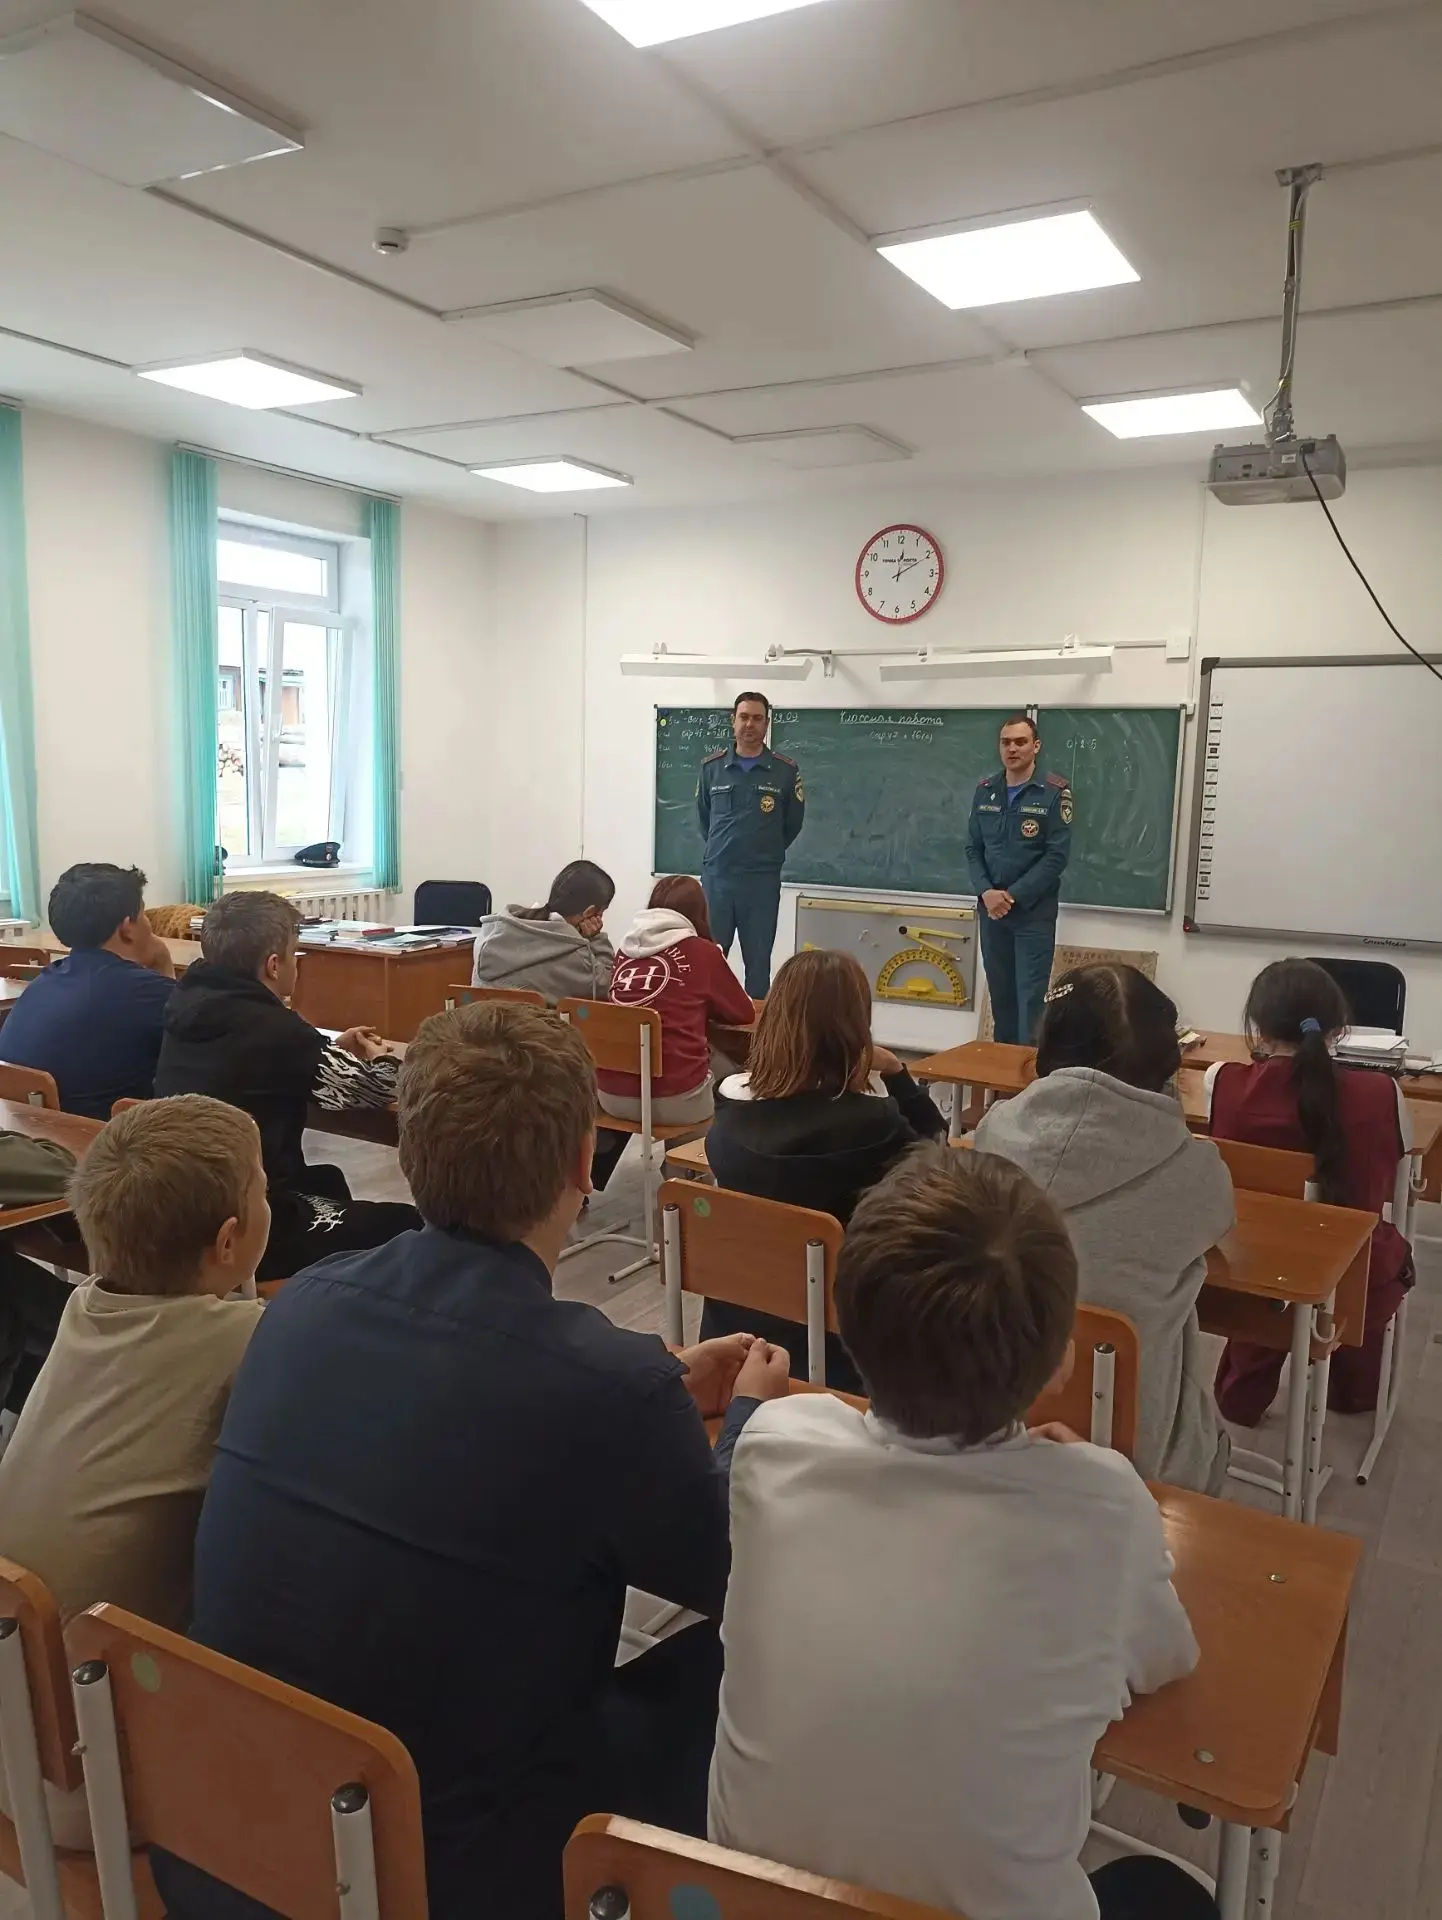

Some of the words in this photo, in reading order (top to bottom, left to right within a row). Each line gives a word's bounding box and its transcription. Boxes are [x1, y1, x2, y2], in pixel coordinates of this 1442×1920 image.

[883, 539, 889, 548] 11
[897, 535, 905, 545] 12
[915, 539, 919, 547] 1
[870, 552, 878, 562] 10
[925, 550, 931, 559] 2
[864, 570, 869, 578] 9
[929, 569, 934, 578] 3
[867, 587, 873, 596] 8
[924, 586, 930, 595] 4
[879, 600, 885, 609] 7
[894, 605, 900, 613] 6
[910, 600, 916, 609] 5
